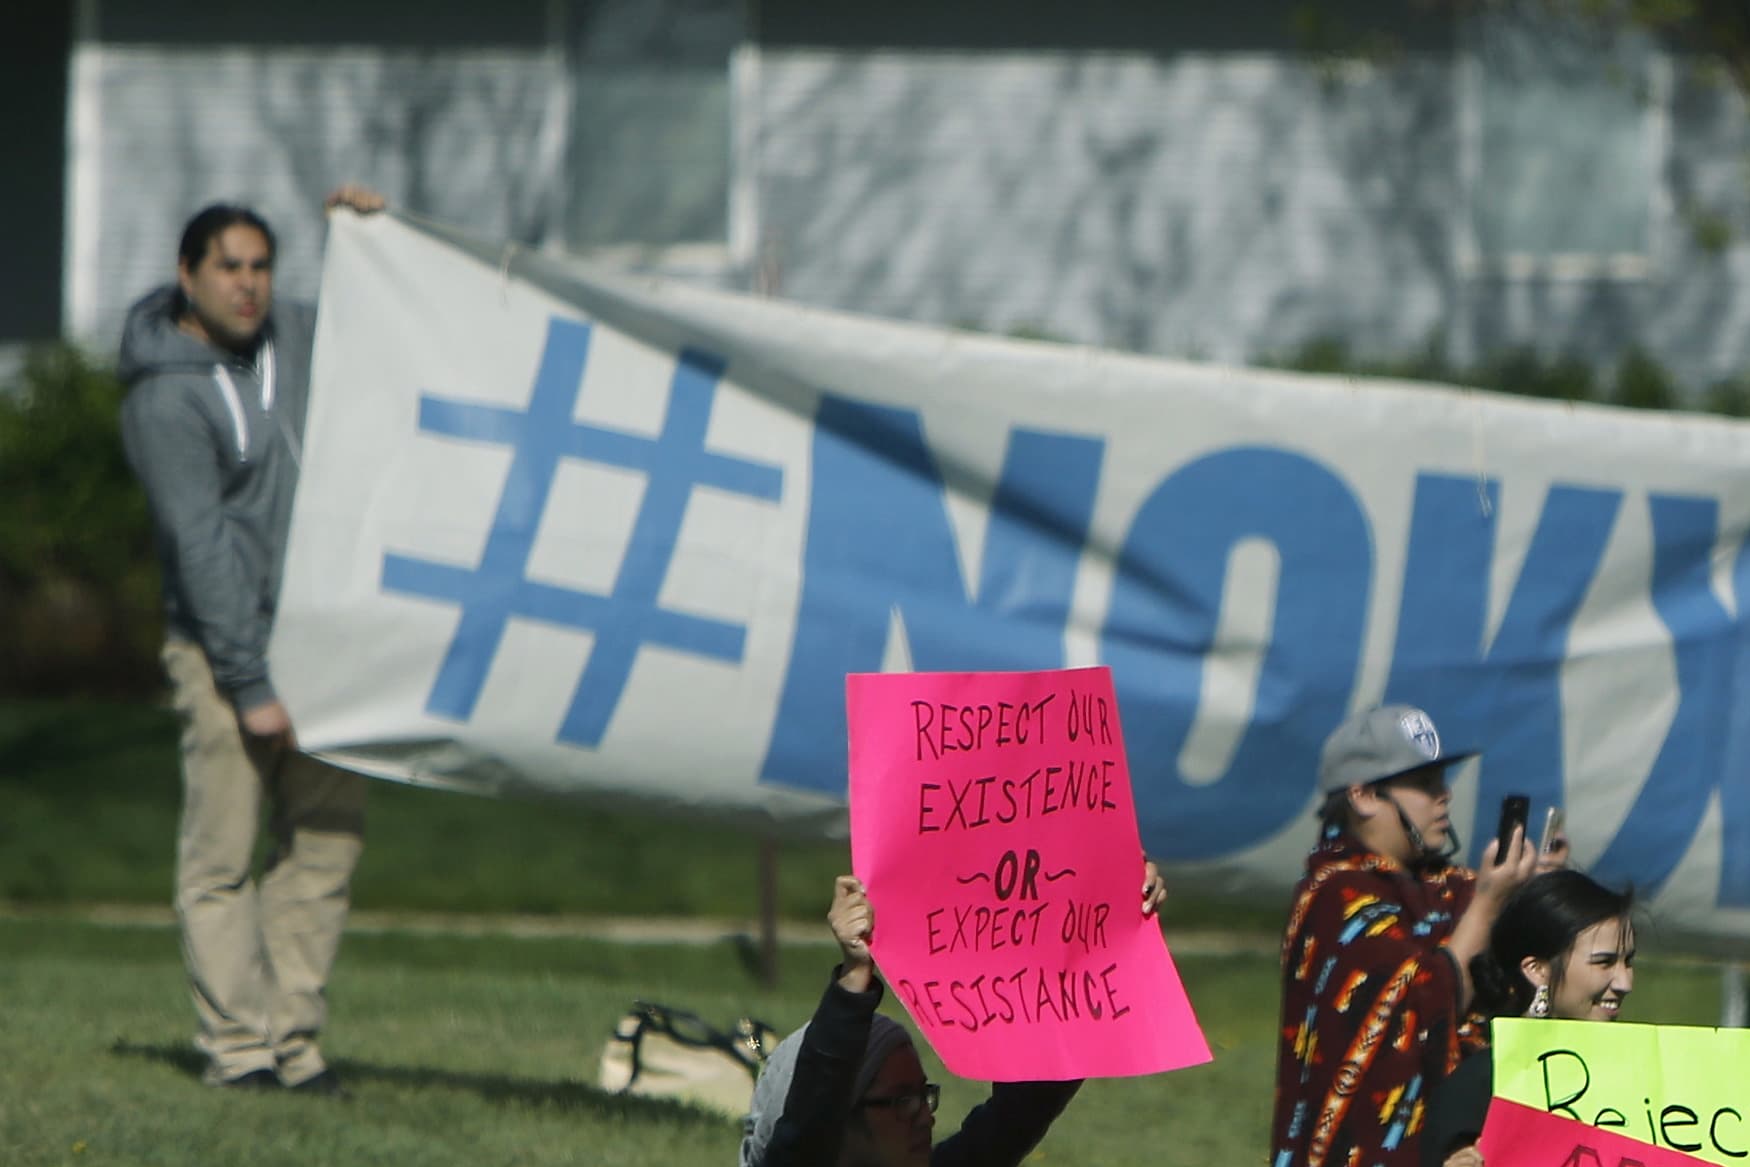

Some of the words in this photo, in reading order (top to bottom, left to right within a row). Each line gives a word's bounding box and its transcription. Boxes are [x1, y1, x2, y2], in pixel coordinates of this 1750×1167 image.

[911, 693, 1056, 761] RESPECT
[1068, 689, 1113, 746] OUR
[918, 760, 1117, 835] EXISTENCE
[926, 902, 1049, 955] EXPECT
[1061, 899, 1111, 953] OUR
[898, 963, 1131, 1033] RESISTANCE
